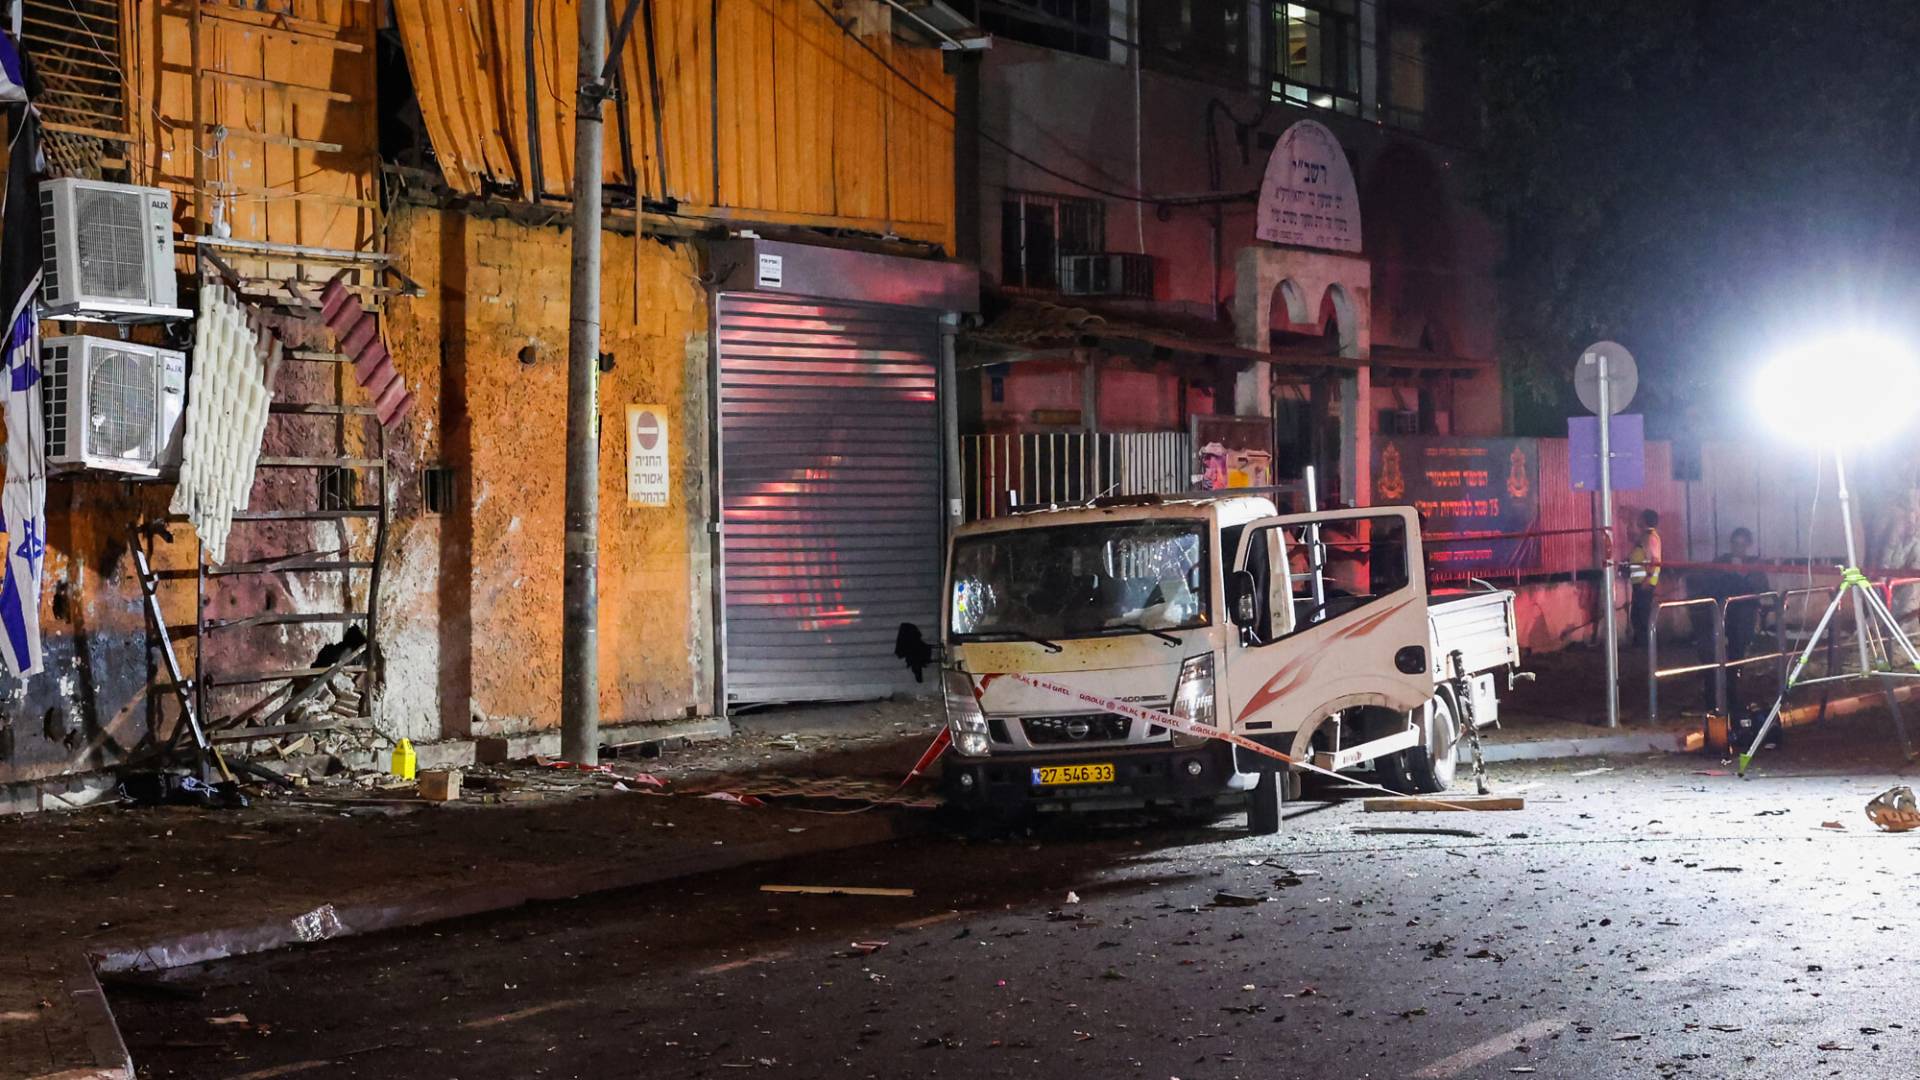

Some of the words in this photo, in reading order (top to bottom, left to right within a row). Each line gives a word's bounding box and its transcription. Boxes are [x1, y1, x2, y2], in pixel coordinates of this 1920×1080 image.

[152, 200, 168, 210] AUX
[635, 455, 662, 468] החניה
[634, 472, 664, 485] אסורה
